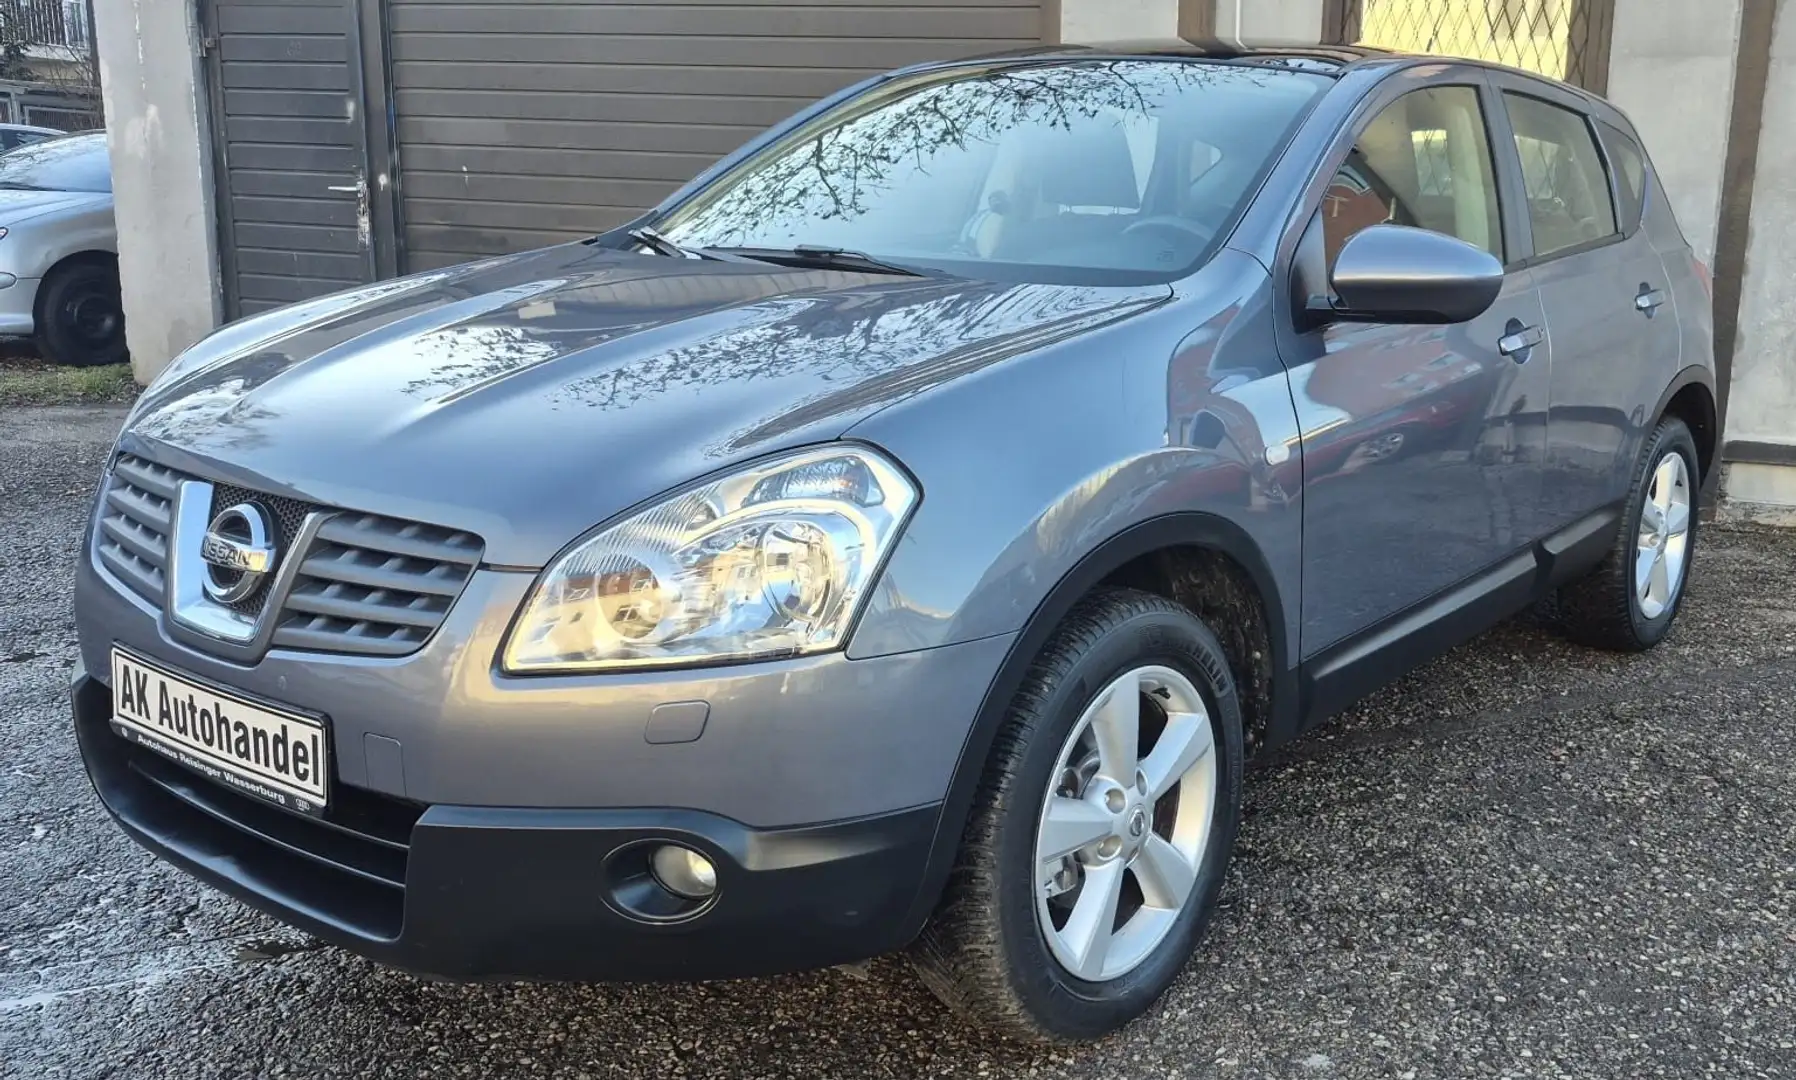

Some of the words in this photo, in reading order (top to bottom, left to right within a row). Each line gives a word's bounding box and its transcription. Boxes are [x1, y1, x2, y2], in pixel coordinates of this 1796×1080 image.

[121, 664, 151, 721] AK
[158, 680, 320, 786] Autohandel
[137, 734, 178, 759] Autohaus
[179, 752, 221, 777] Reisinger
[223, 771, 285, 804] Wasserburg
